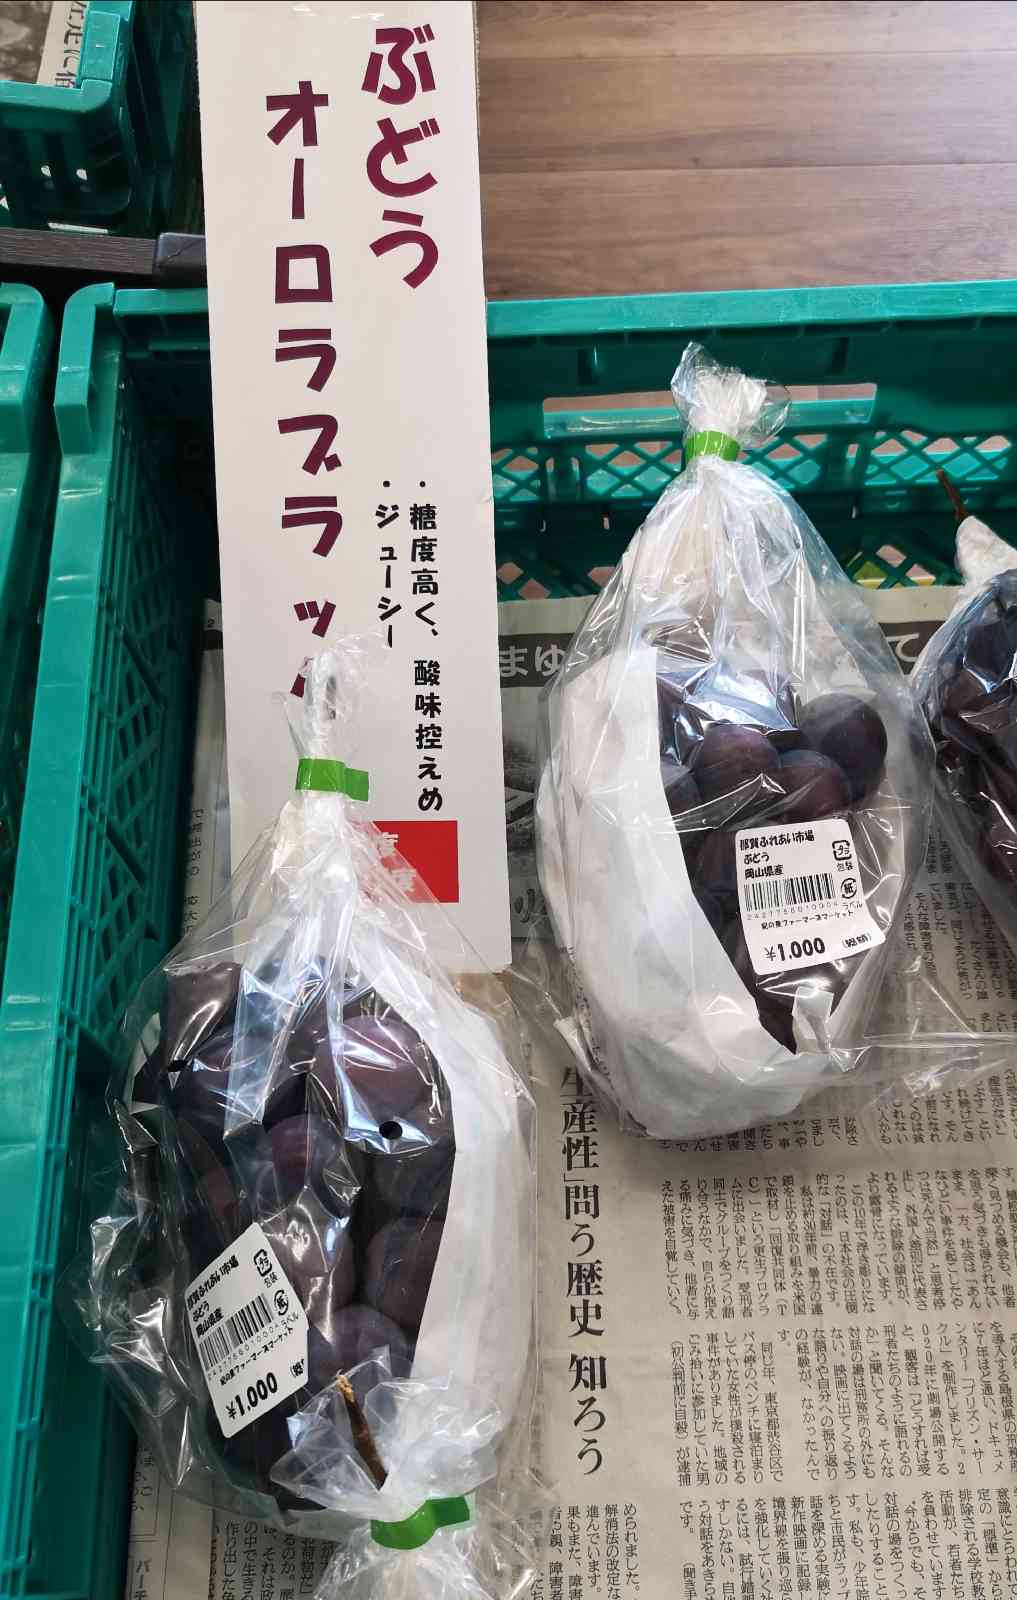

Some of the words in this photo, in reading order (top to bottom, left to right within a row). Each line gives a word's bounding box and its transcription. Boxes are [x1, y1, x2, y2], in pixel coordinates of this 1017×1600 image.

[361, 23, 440, 289] ぶどう
[744, 851, 769, 865] ぶどう
[745, 864, 784, 880] 岡山県産
[568, 1352, 607, 1476] 知ろう
